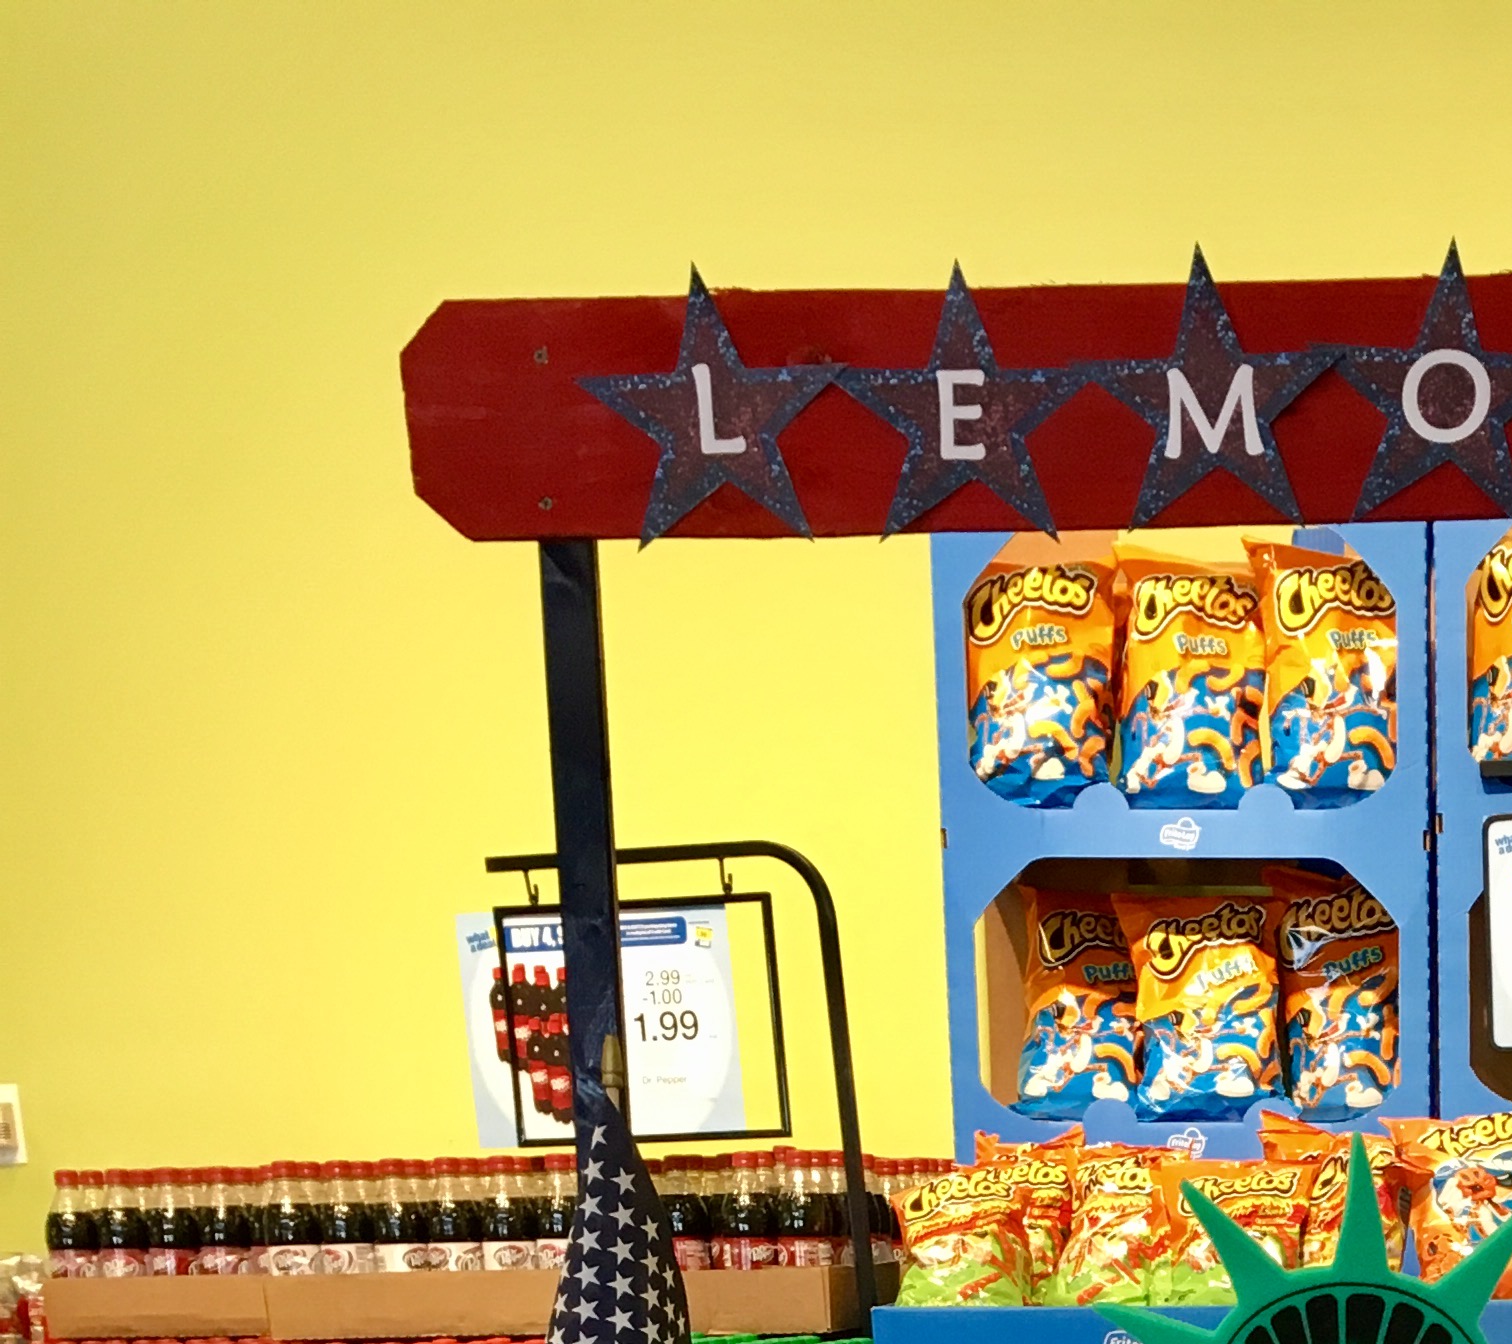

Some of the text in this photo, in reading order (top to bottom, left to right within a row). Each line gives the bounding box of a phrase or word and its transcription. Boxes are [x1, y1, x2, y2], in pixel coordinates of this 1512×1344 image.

[970, 566, 1095, 642] Cheetos
[1136, 576, 1258, 634] Cheetos
[1279, 565, 1394, 634] Cheetos
[1012, 626, 1067, 650] Puffs
[1176, 633, 1226, 656] Puffs
[510, 926, 540, 948] BUY
[1041, 912, 1128, 963] Cheet
[1145, 903, 1264, 978] Cheetos
[645, 969, 681, 986] 2.99
[1085, 964, 1134, 985] Puff
[643, 988, 682, 1005] -1.00
[634, 1010, 699, 1042] 1.99
[657, 1076, 687, 1085] Pepper
[904, 1171, 1013, 1221] Cheetos
